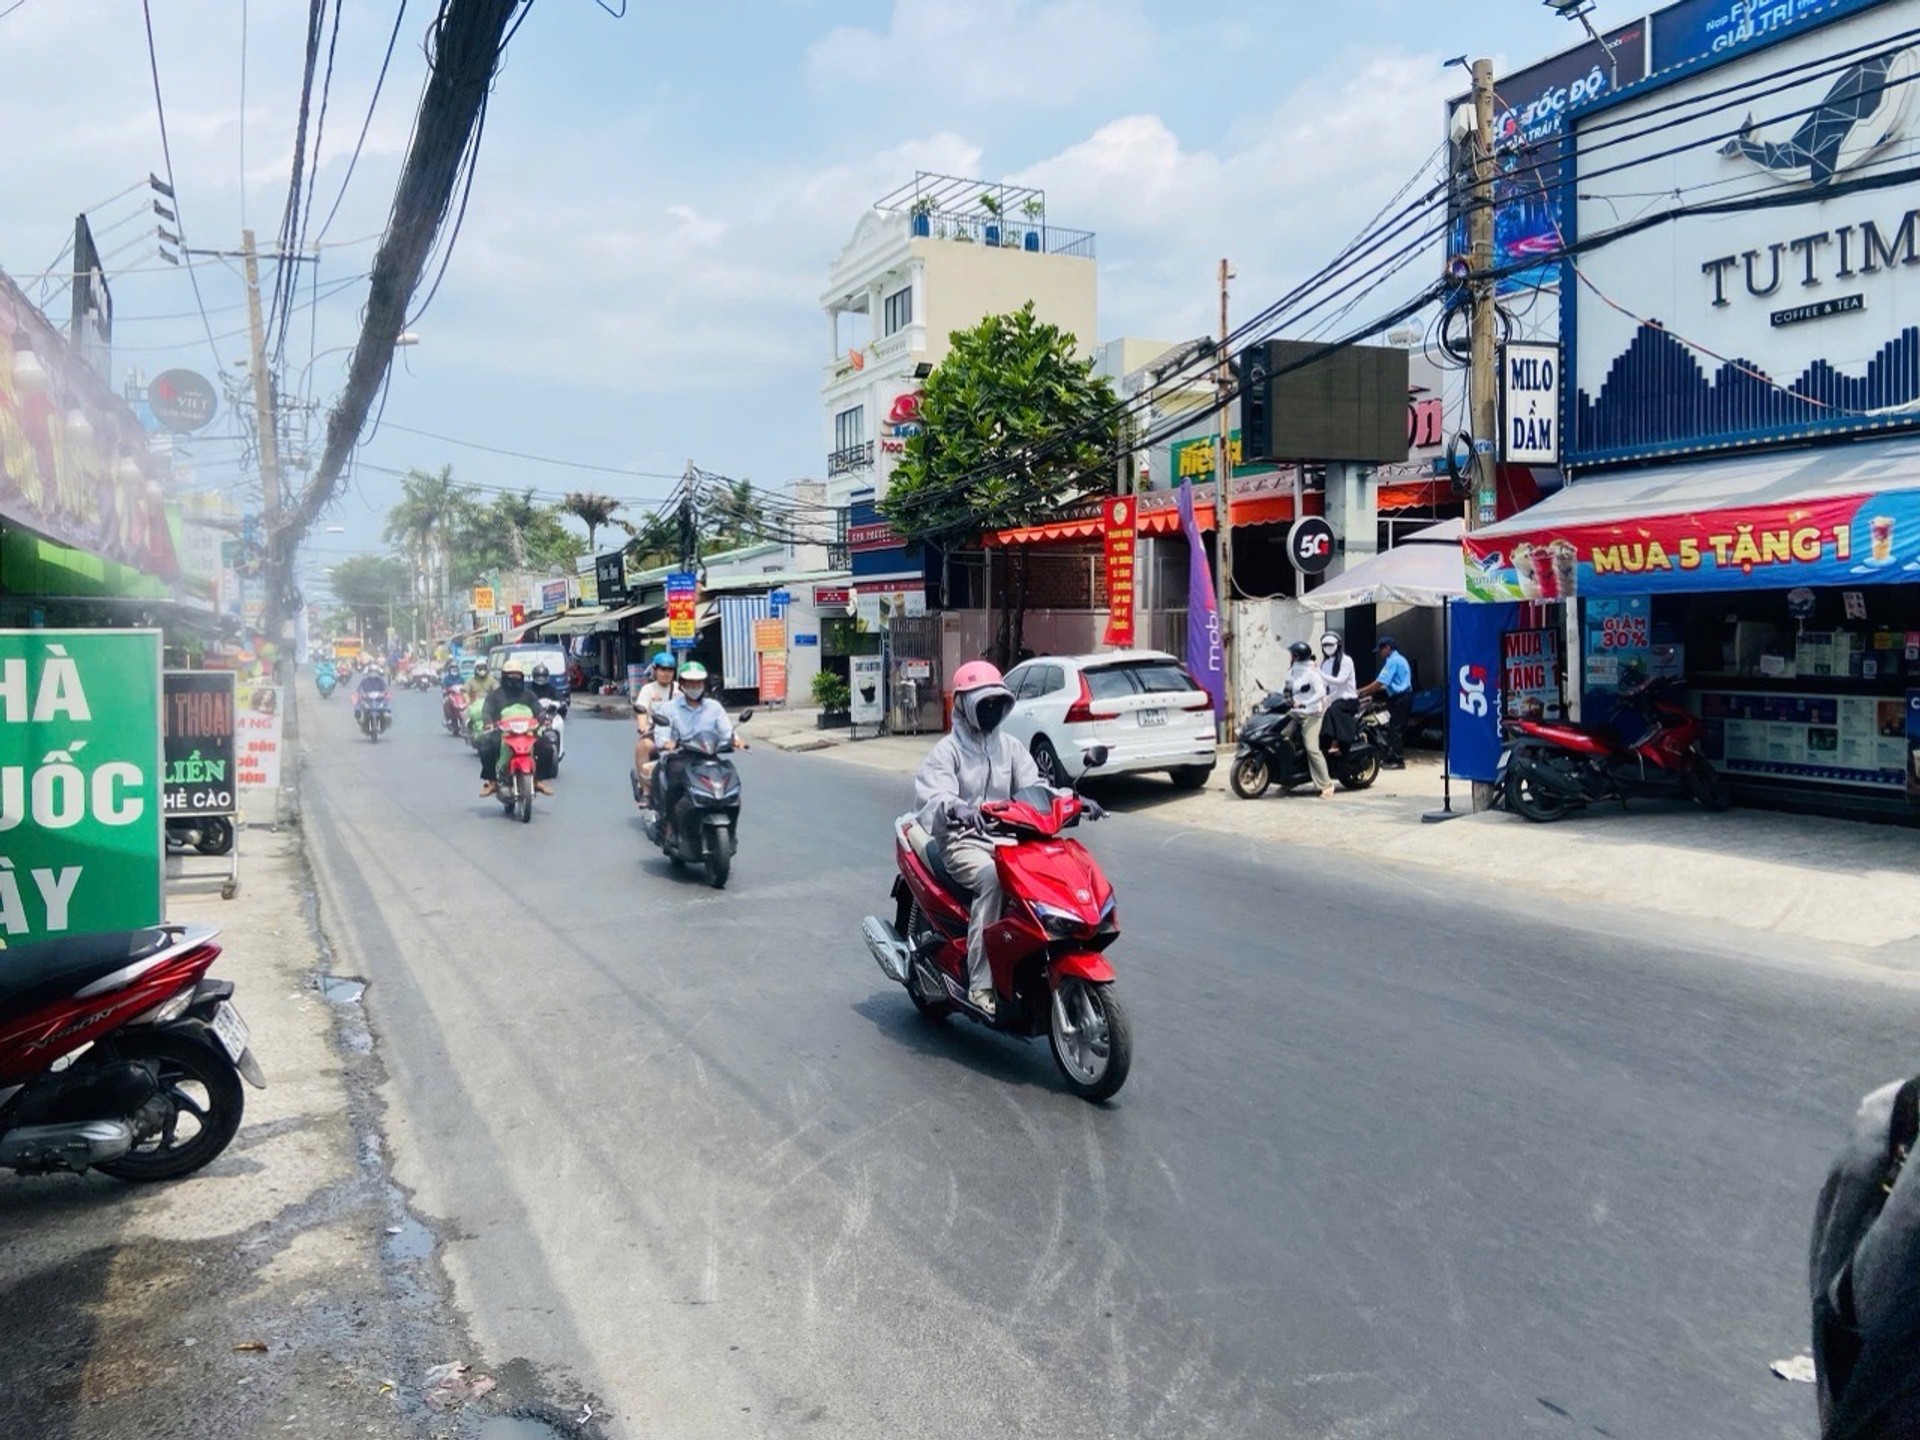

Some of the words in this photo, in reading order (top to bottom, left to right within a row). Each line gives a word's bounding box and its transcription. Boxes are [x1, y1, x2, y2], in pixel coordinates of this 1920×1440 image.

[1569, 65, 1605, 103] ĐỘ
[1774, 307, 1819, 324] COFFEE
[1824, 304, 1833, 314] &
[1838, 297, 1861, 312] TEA
[1511, 357, 1553, 391] MILO
[1513, 399, 1552, 450] DẦM
[1300, 533, 1329, 558] 5G
[1591, 541, 1672, 575] MUA
[1680, 537, 1701, 569] 5
[1708, 523, 1822, 574] TẶNG
[1833, 523, 1851, 559] 1
[1504, 632, 1543, 658] MUA
[1548, 631, 1557, 654] 1
[1602, 631, 1650, 649] 30%
[1459, 664, 1487, 718] 5G
[193, 787, 231, 808] CÀO
